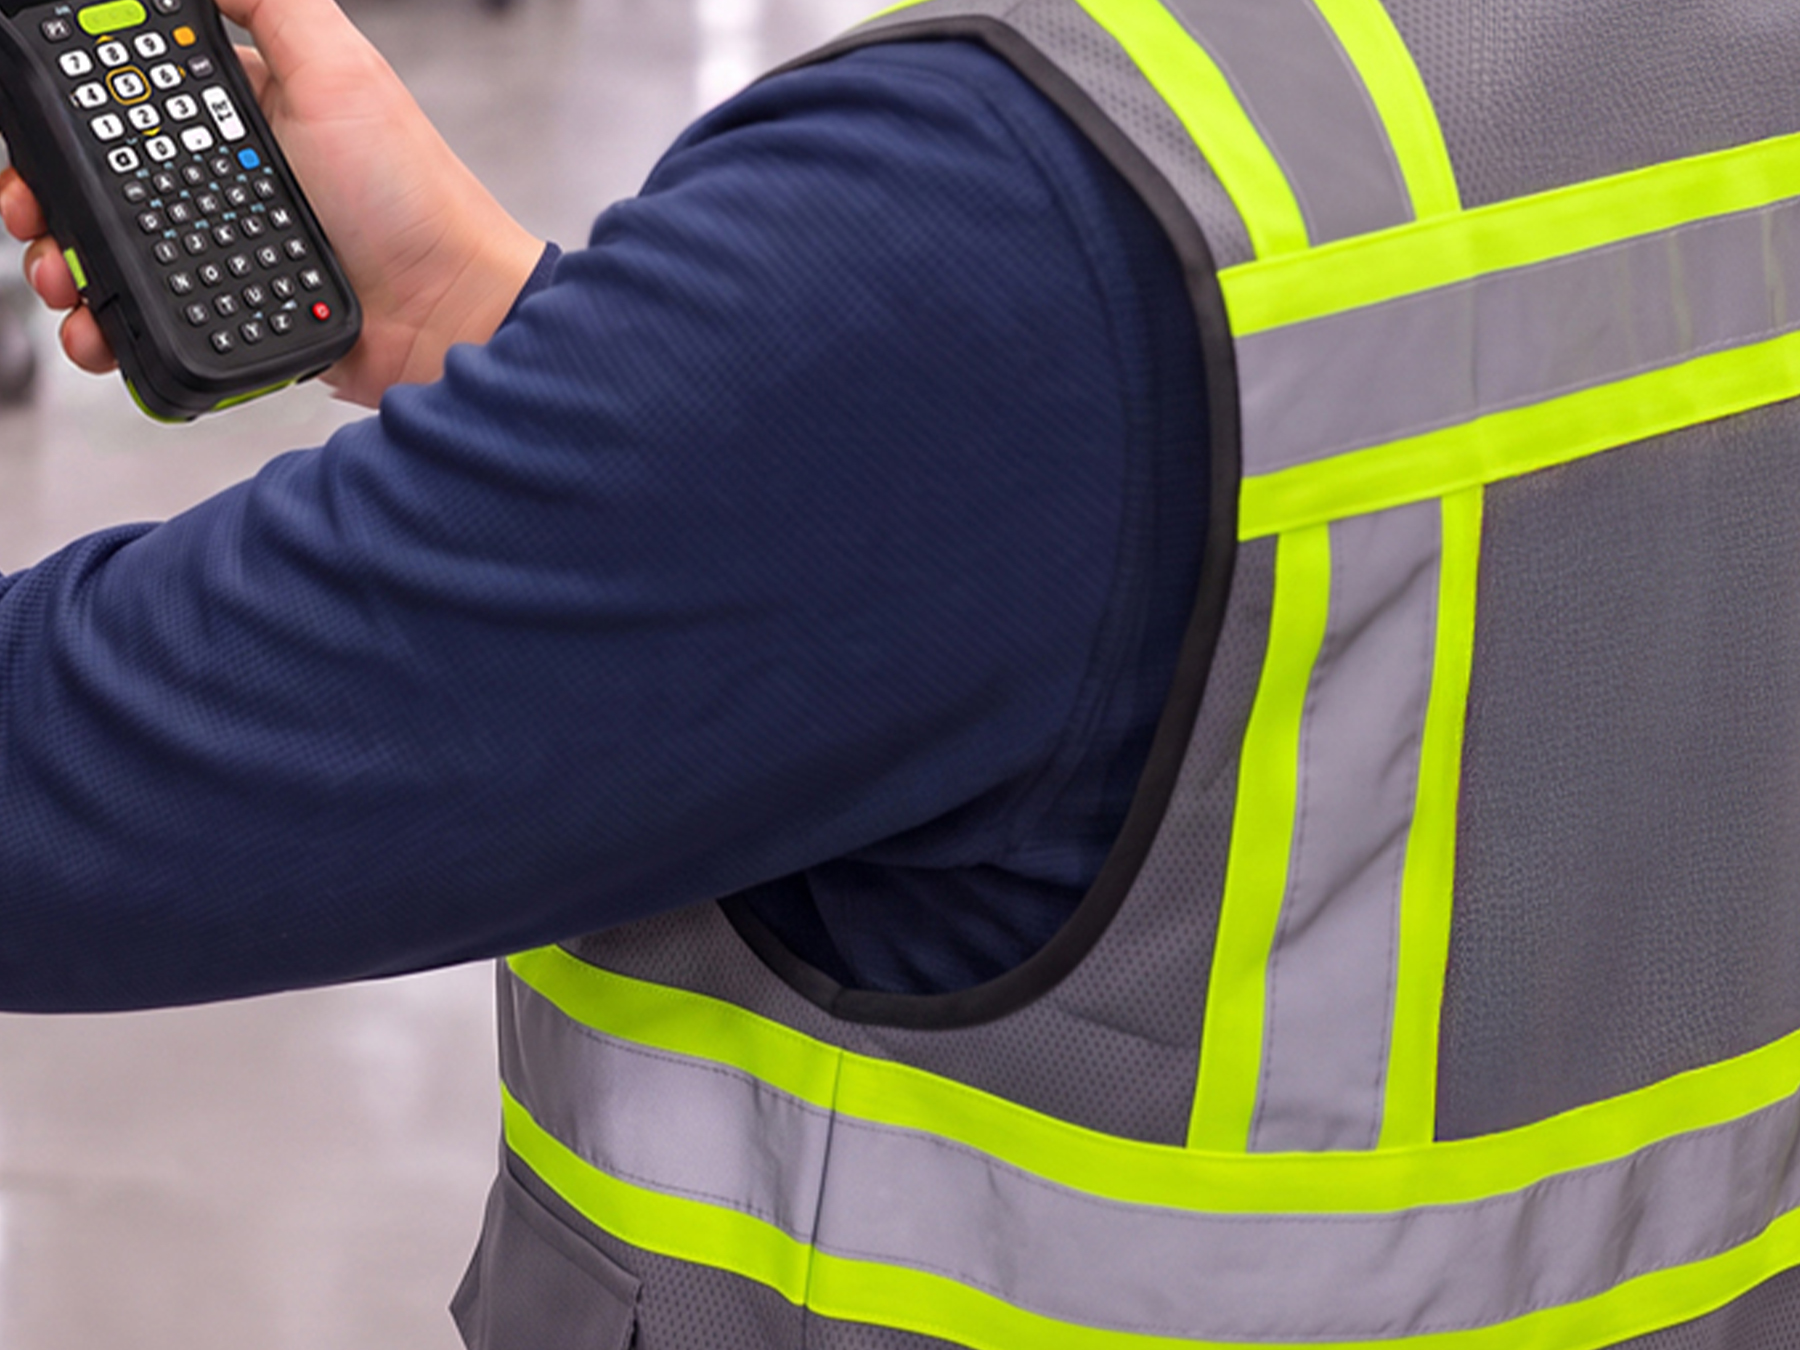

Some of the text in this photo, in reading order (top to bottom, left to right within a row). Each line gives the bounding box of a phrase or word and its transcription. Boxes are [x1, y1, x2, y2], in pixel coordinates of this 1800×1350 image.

[68, 37, 156, 71] 7 8 9
[87, 68, 173, 102] 4 5 6
[101, 119, 114, 134] 1
[137, 109, 151, 125] 2
[175, 99, 189, 115] 3
